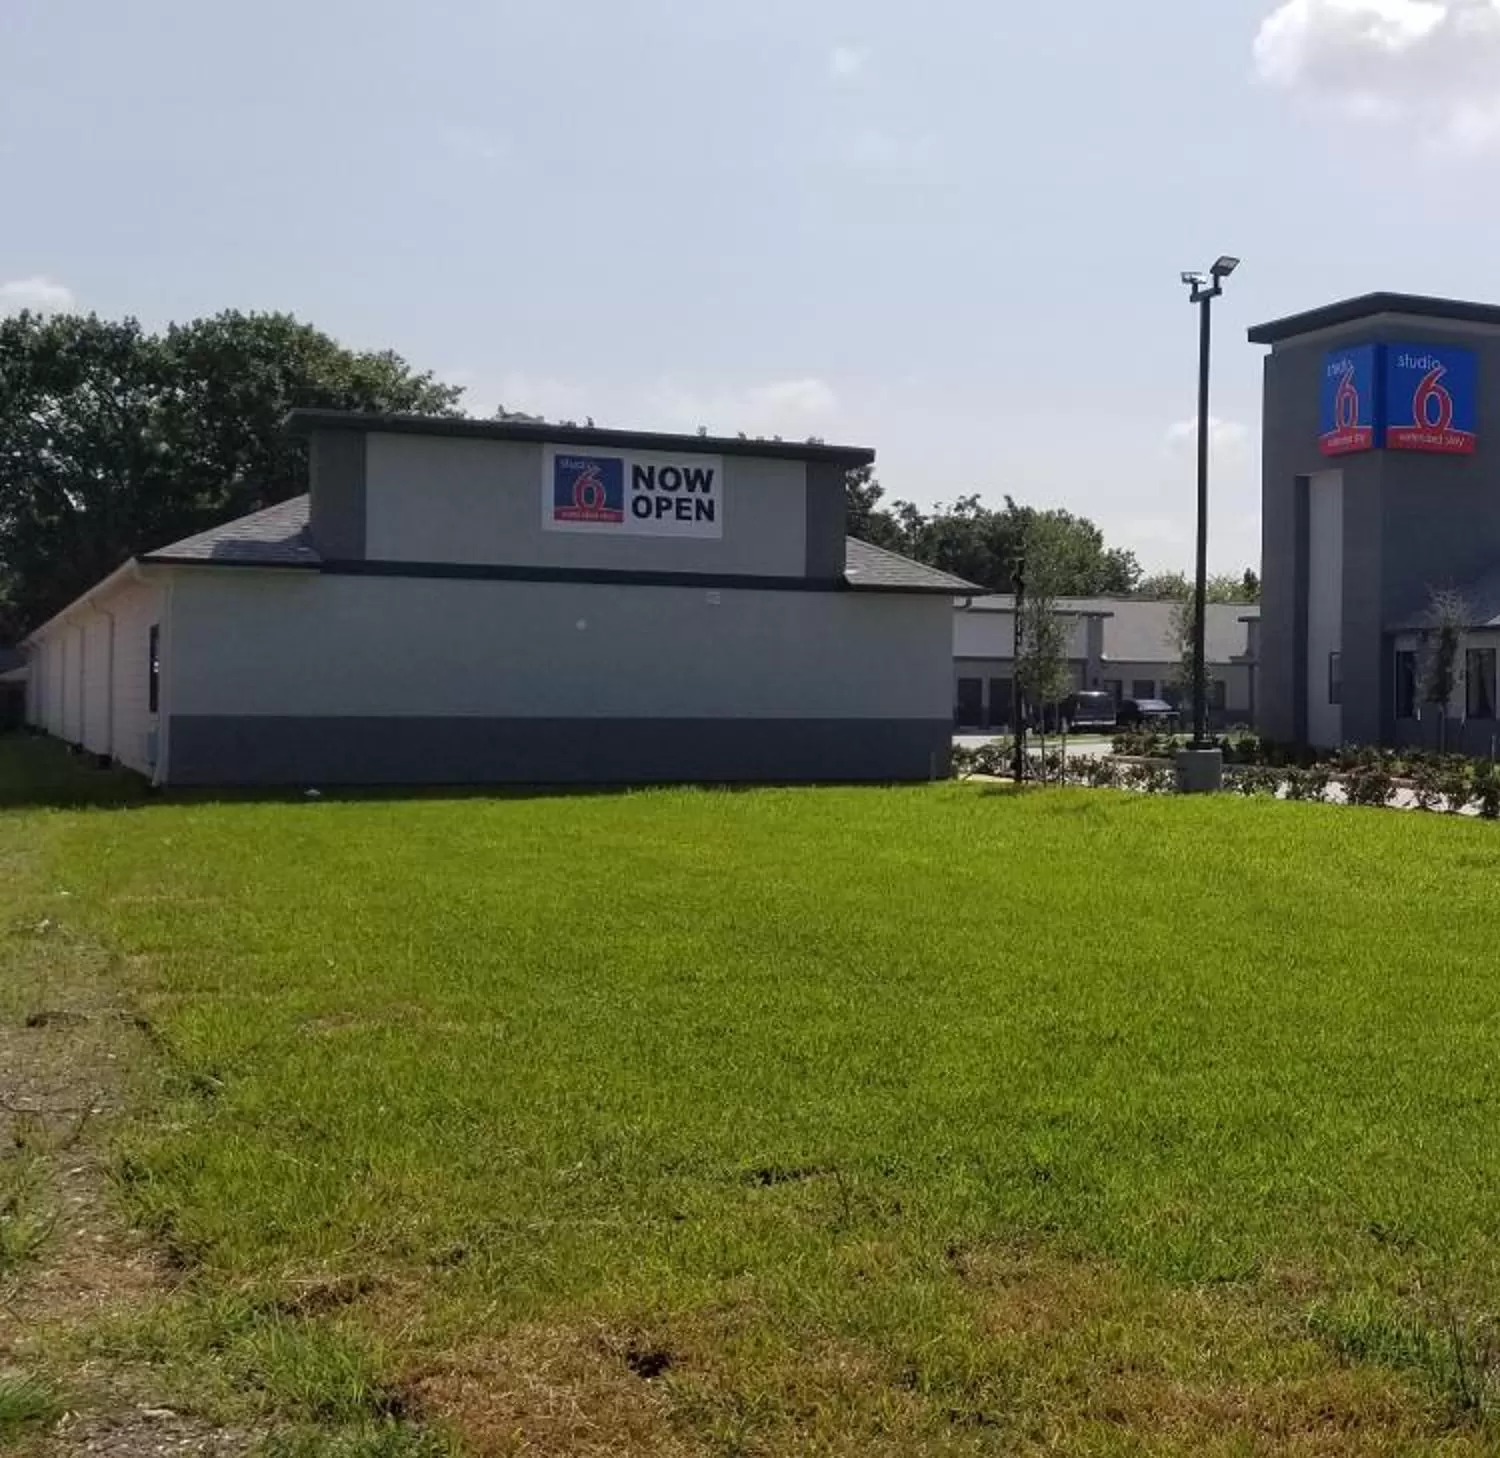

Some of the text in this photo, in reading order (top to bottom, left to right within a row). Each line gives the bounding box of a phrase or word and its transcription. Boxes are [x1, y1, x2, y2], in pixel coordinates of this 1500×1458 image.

[1397, 353, 1441, 370] studio
[1412, 364, 1453, 430] 6
[632, 464, 714, 493] NOW
[632, 495, 716, 522] OPEN
